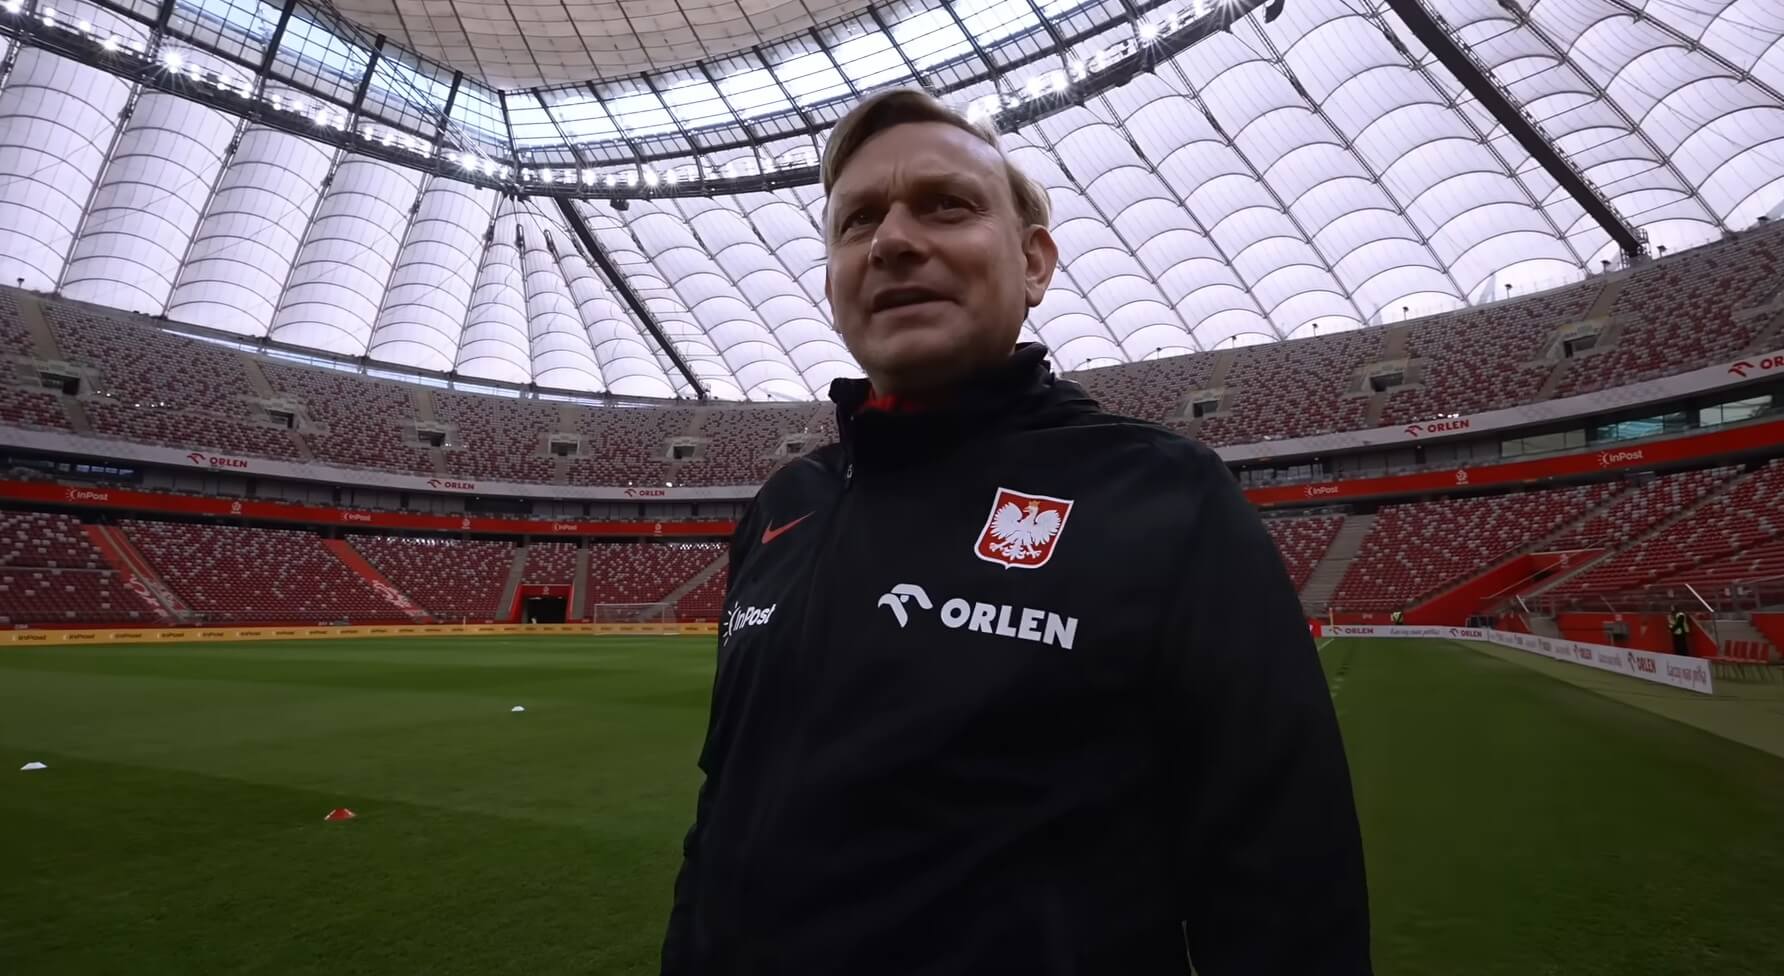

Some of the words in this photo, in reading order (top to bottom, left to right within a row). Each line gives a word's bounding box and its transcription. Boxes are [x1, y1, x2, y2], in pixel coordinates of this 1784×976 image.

[1427, 419, 1470, 433] ORLEN
[209, 456, 248, 468] ORLEN
[1609, 450, 1643, 462] InPost
[444, 481, 475, 490] ORLEN
[1313, 485, 1339, 495] InPost
[77, 491, 108, 501] InPost
[733, 603, 776, 631] InPost
[940, 598, 1079, 650] ORLEN
[1637, 656, 1656, 674] ORLEN
